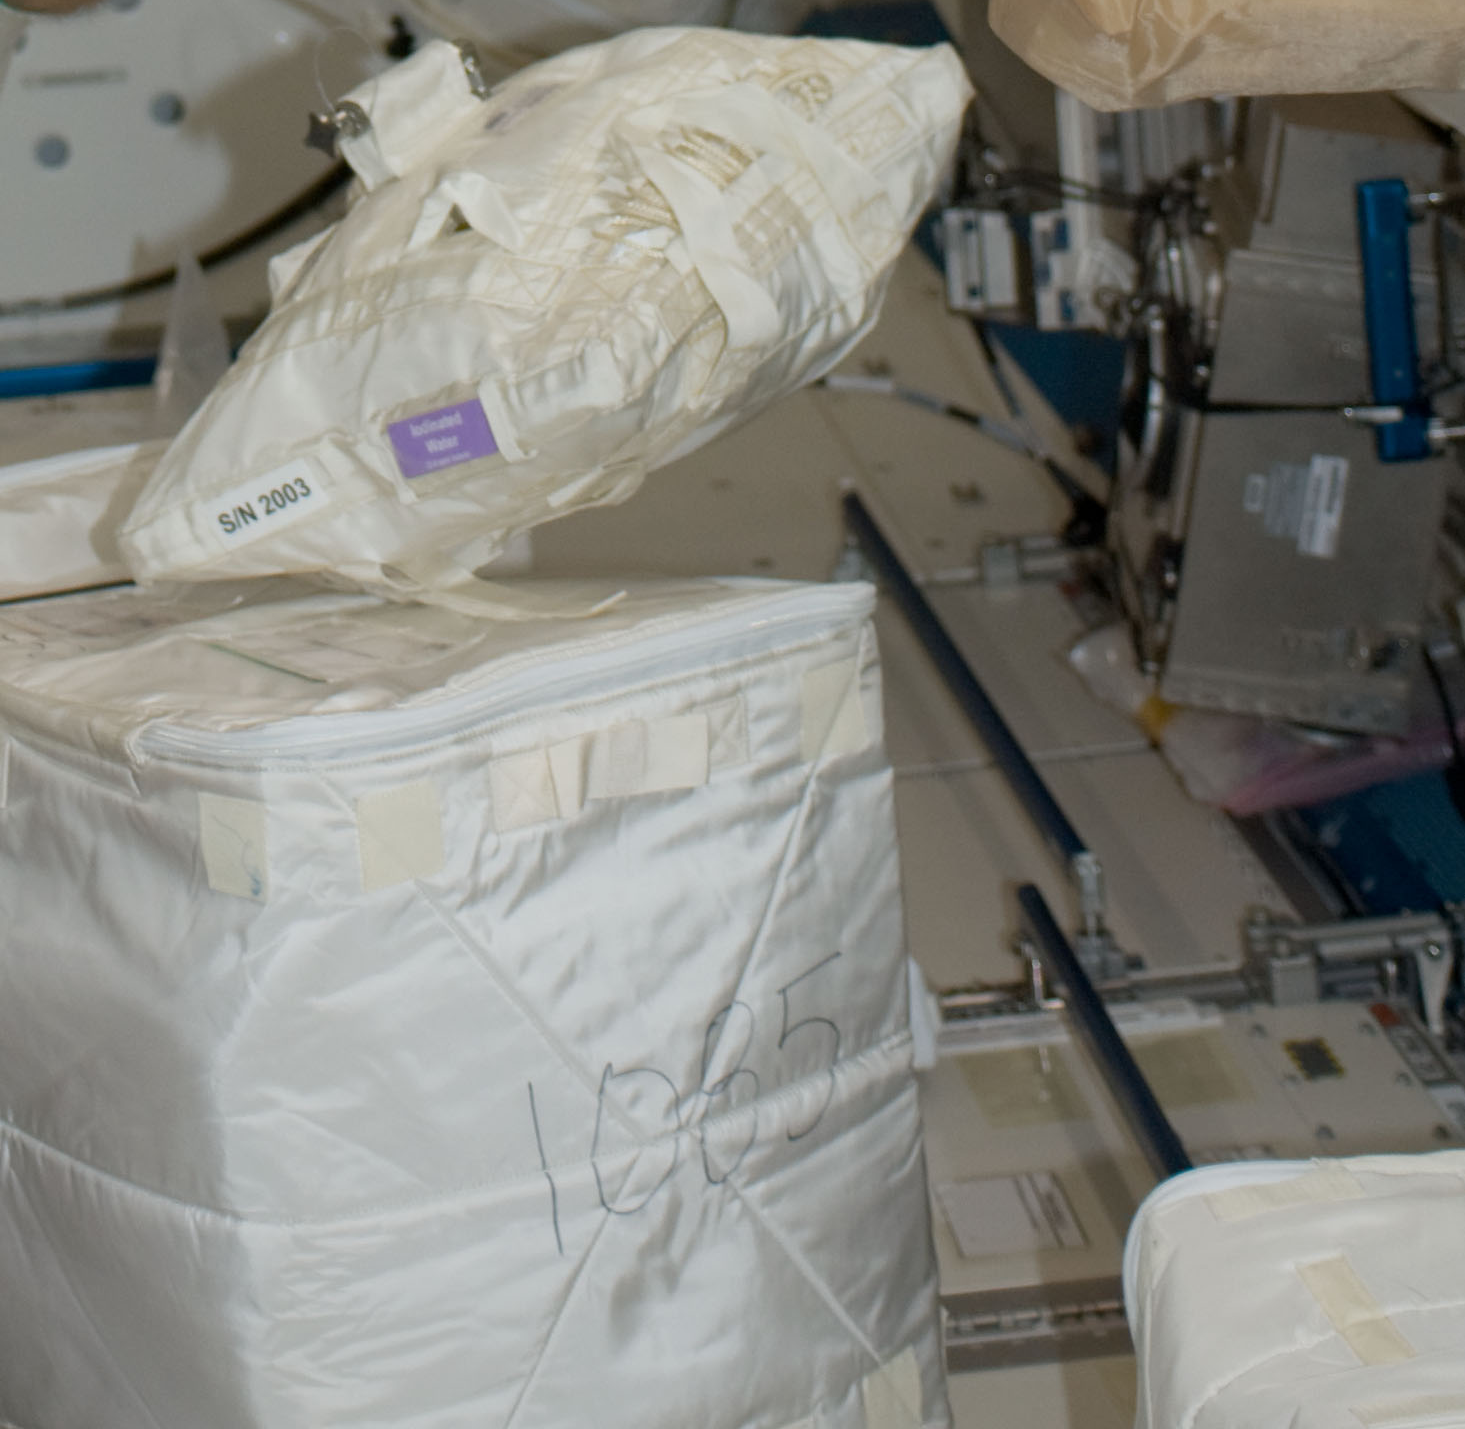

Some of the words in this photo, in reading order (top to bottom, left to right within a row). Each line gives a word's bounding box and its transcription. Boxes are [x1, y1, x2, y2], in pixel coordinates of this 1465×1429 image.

[423, 434, 460, 455] Water
[218, 500, 259, 535] S/N
[257, 475, 313, 516] 2003
